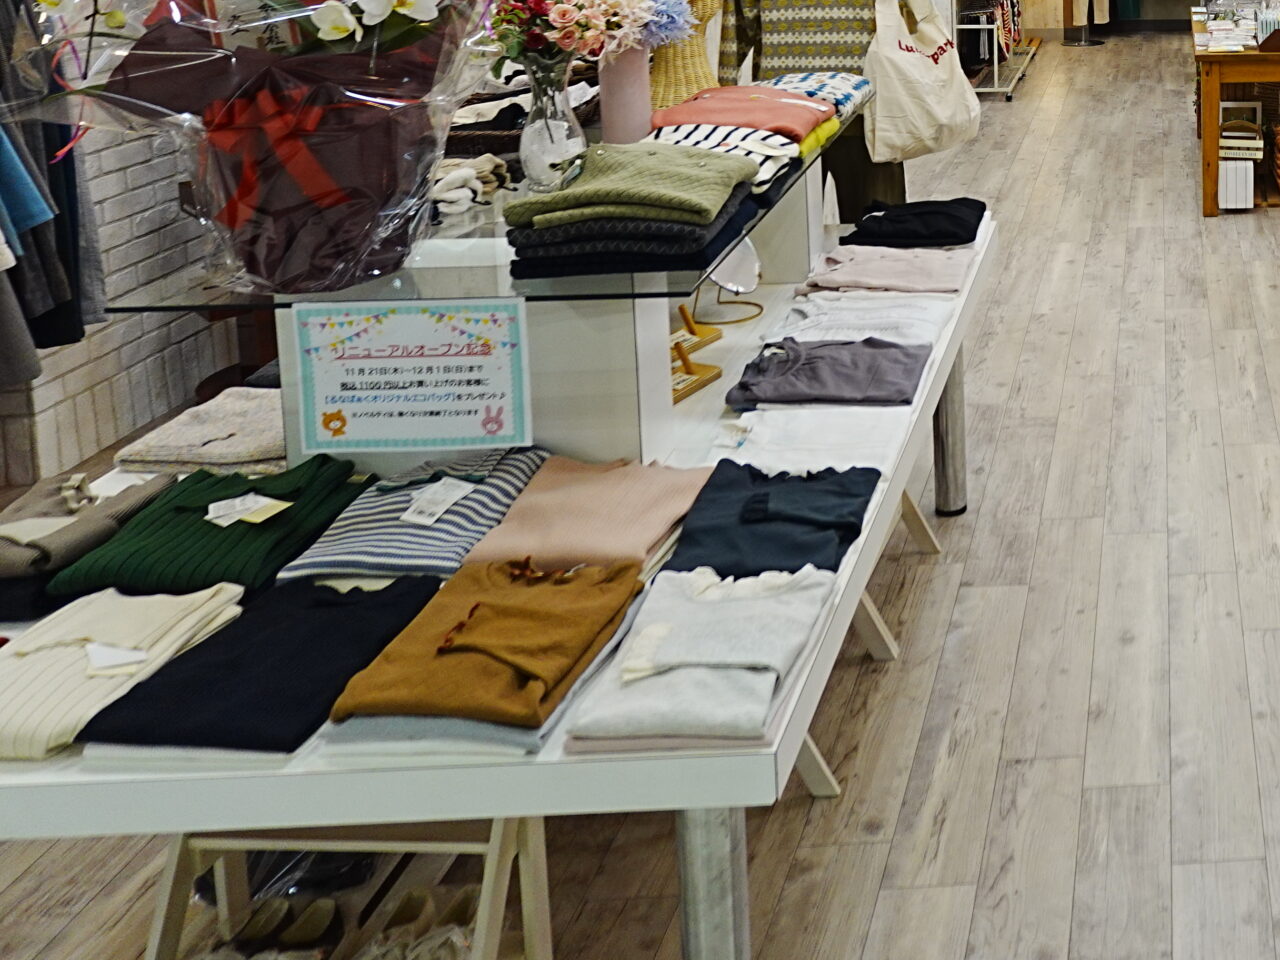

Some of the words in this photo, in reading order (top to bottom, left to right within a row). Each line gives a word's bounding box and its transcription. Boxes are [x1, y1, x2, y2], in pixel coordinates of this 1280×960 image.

[331, 343, 492, 359] リニューアルオープン記念
